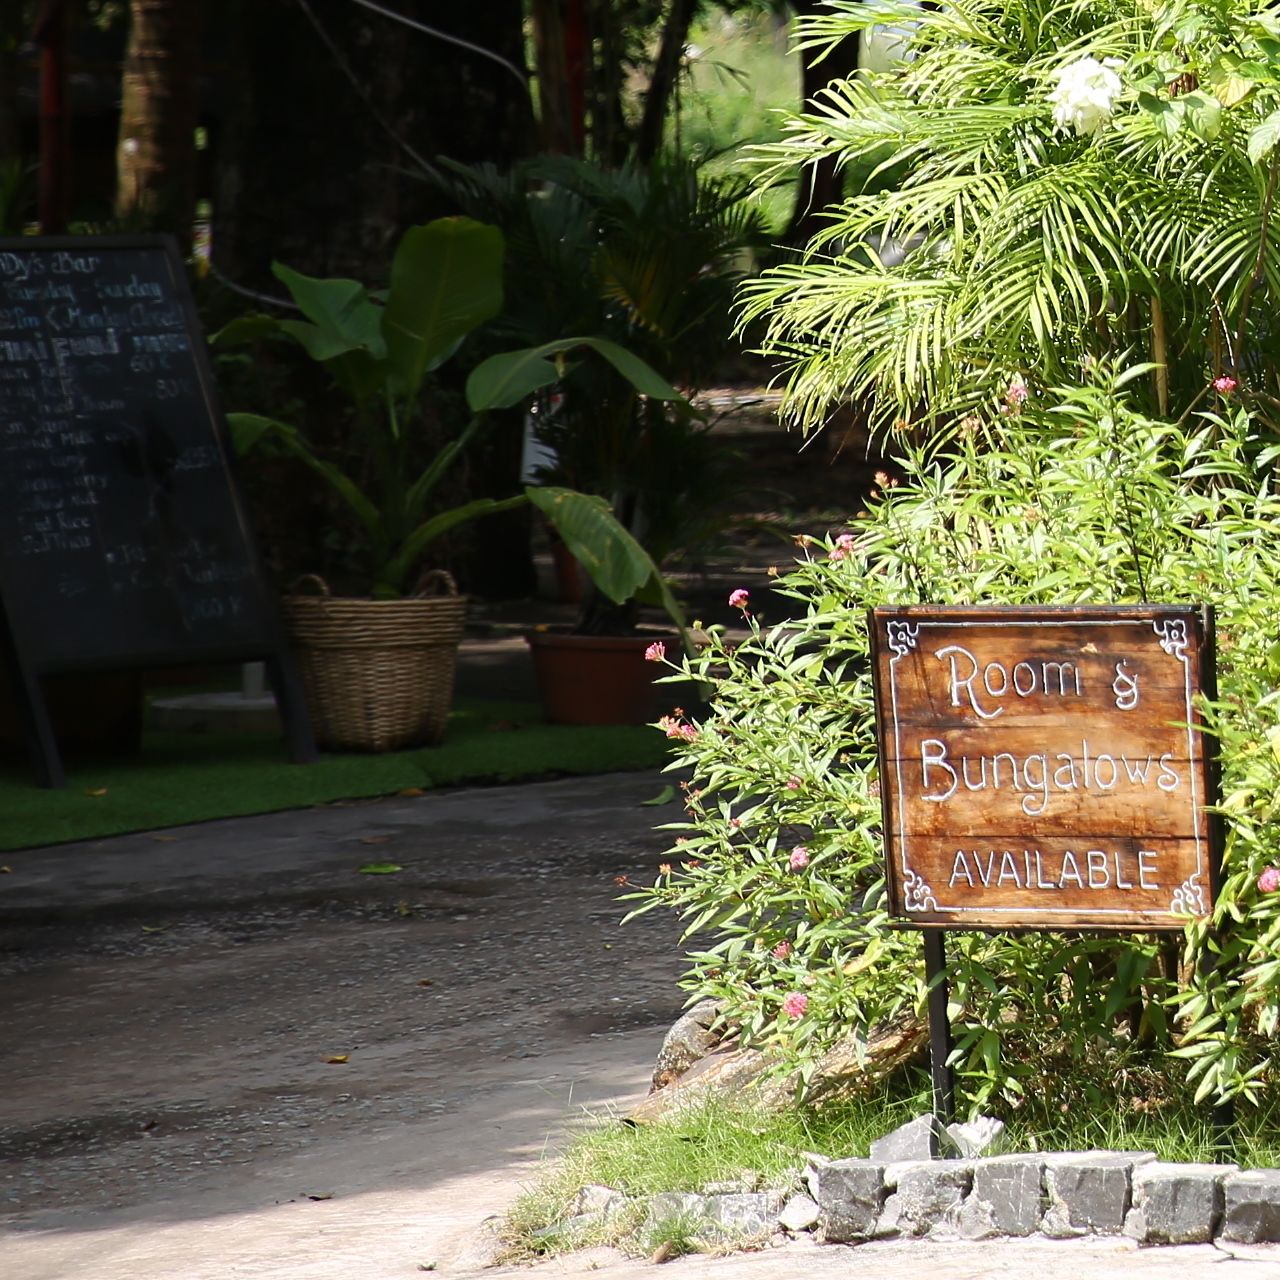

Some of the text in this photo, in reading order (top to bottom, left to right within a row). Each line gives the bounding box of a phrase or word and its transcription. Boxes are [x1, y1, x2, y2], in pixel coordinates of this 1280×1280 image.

[934, 645, 1082, 719] Room
[920, 738, 1181, 817] Bungalows
[948, 849, 1160, 890] AVAILABLE
